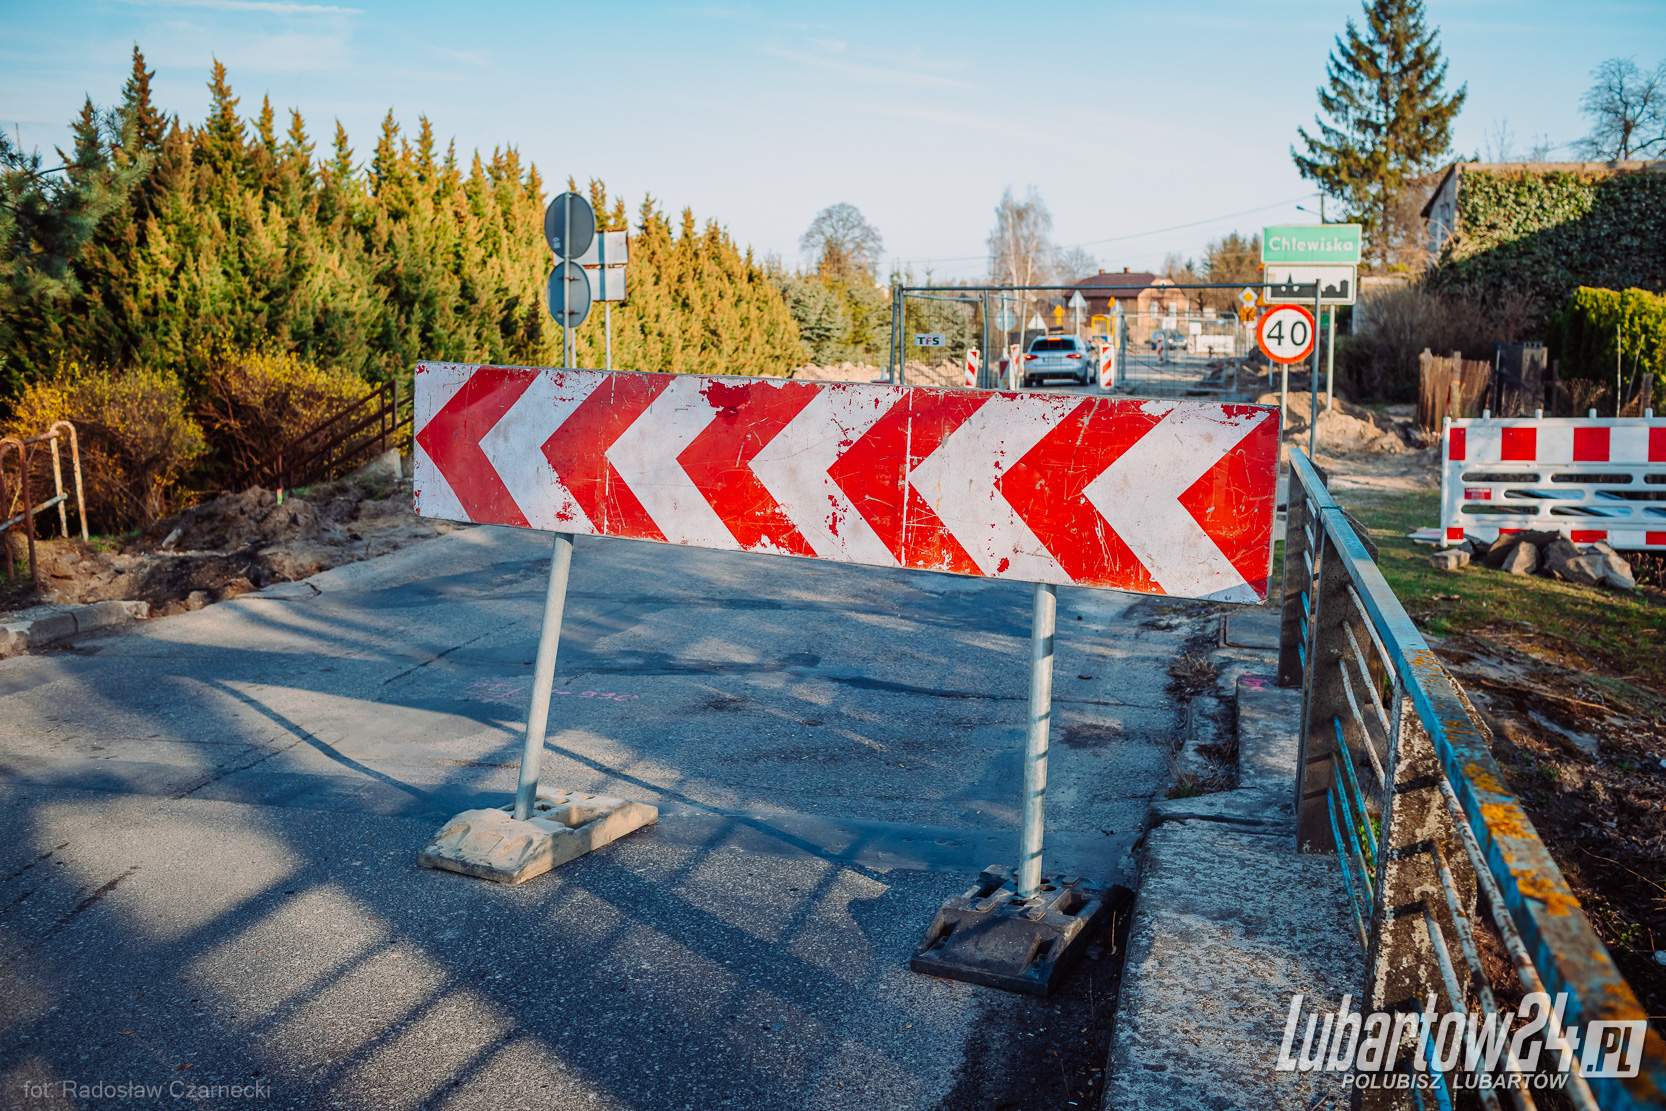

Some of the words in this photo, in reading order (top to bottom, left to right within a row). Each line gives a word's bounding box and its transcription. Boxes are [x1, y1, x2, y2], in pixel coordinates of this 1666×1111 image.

[1269, 236, 1353, 252] Chlewiska
[917, 336, 939, 345] TFS
[1267, 320, 1307, 346] 40
